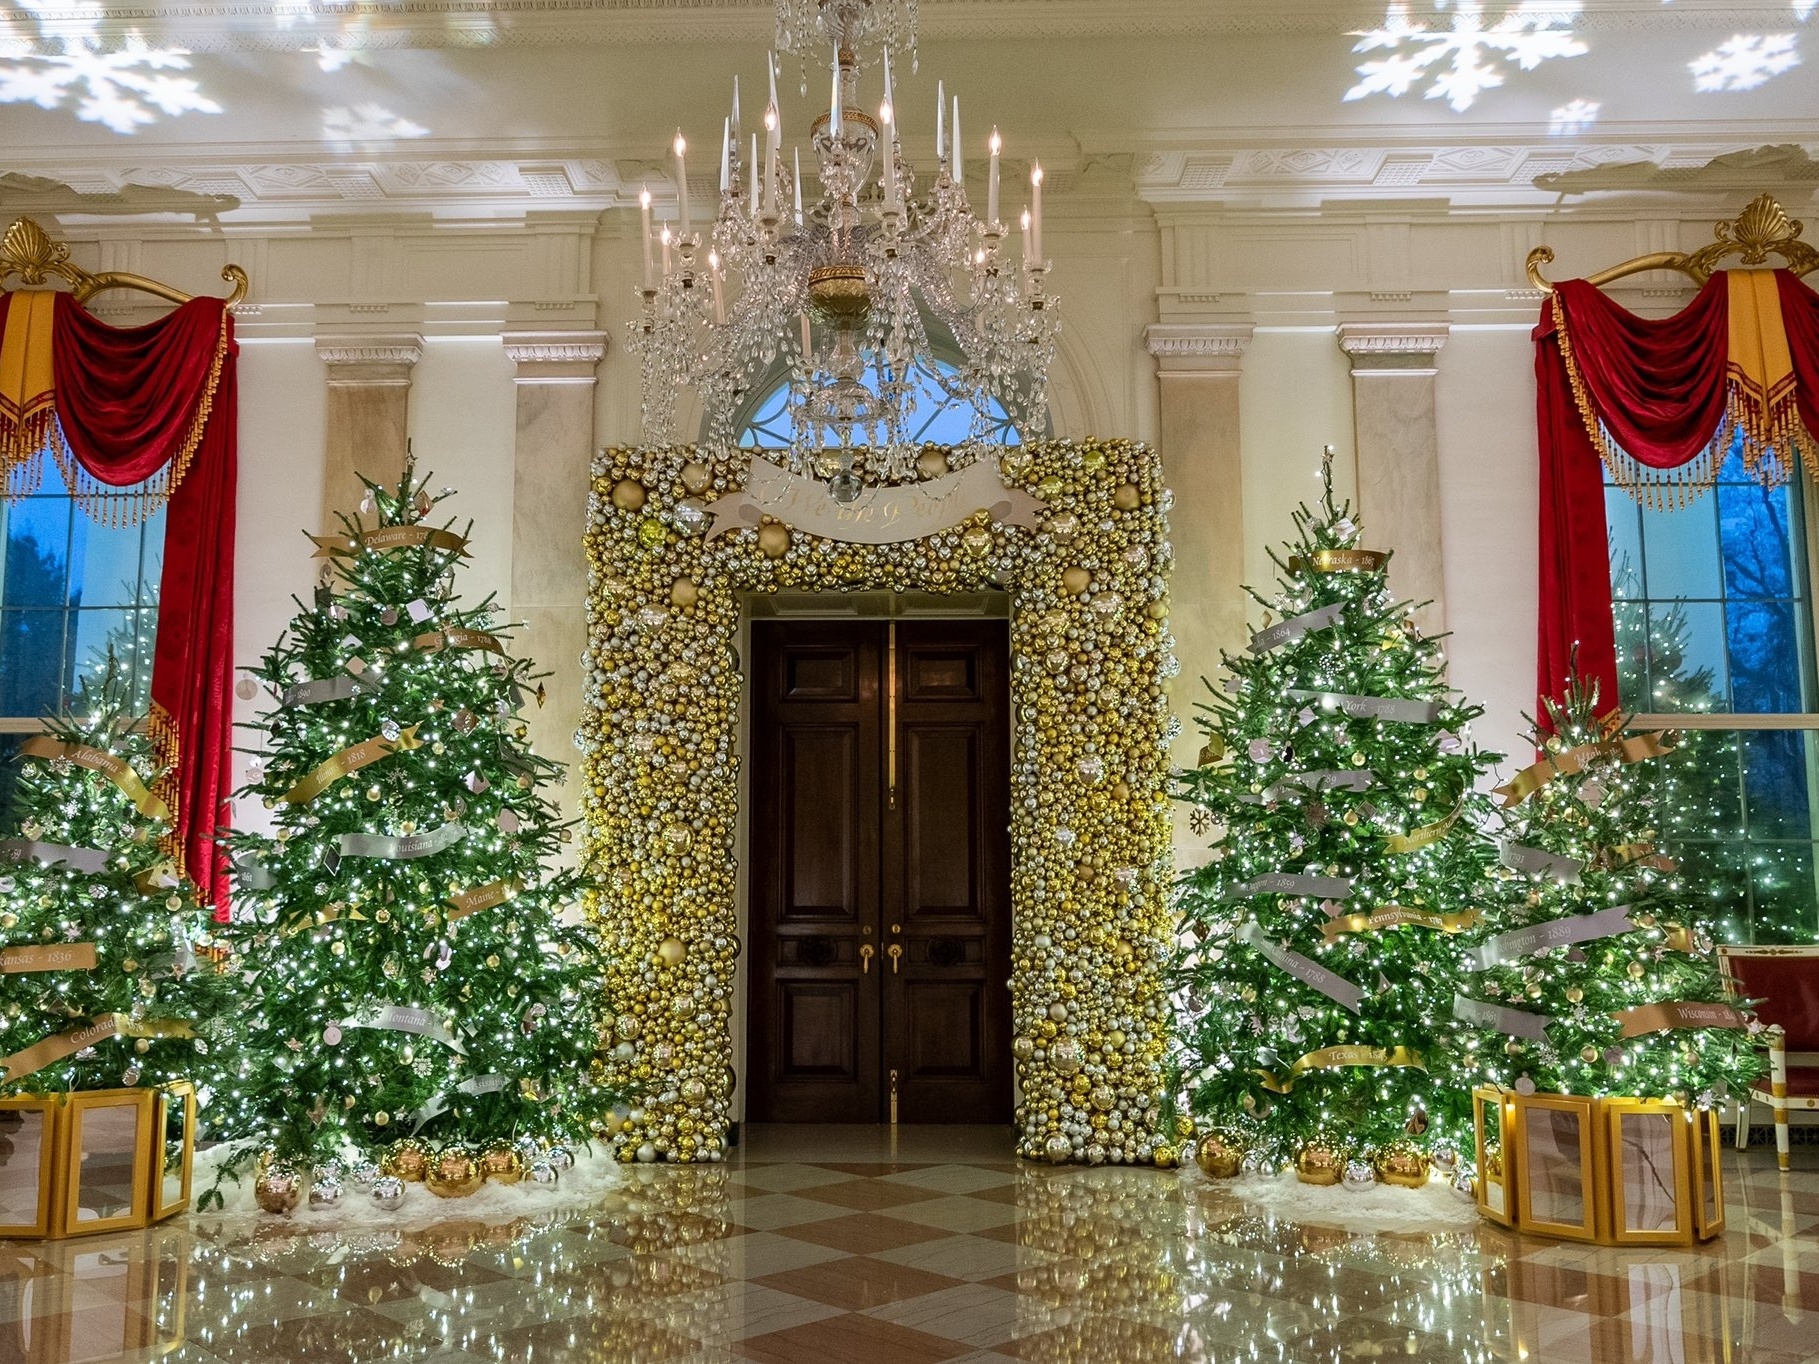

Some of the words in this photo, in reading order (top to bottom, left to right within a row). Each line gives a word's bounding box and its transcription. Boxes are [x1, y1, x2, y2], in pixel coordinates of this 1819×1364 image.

[365, 529, 406, 547] Delaware
[1312, 553, 1353, 567] Neraska
[1361, 555, 1375, 567] 1867
[1273, 627, 1292, 641] 1864
[1346, 699, 1368, 711] York
[1377, 703, 1396, 714] 1788
[71, 749, 120, 774] Alabama
[347, 748, 366, 765] 1818
[1276, 879, 1296, 889] 1859
[466, 890, 496, 909] Maine
[1368, 906, 1423, 925] Pennsylvania
[1548, 925, 1572, 940] 1889
[48, 949, 73, 964] 1836
[1305, 968, 1327, 983] 1788
[1676, 1006, 1717, 1020] Wisconsin
[70, 1017, 116, 1045] Colorad
[1329, 1051, 1359, 1062] Texas
